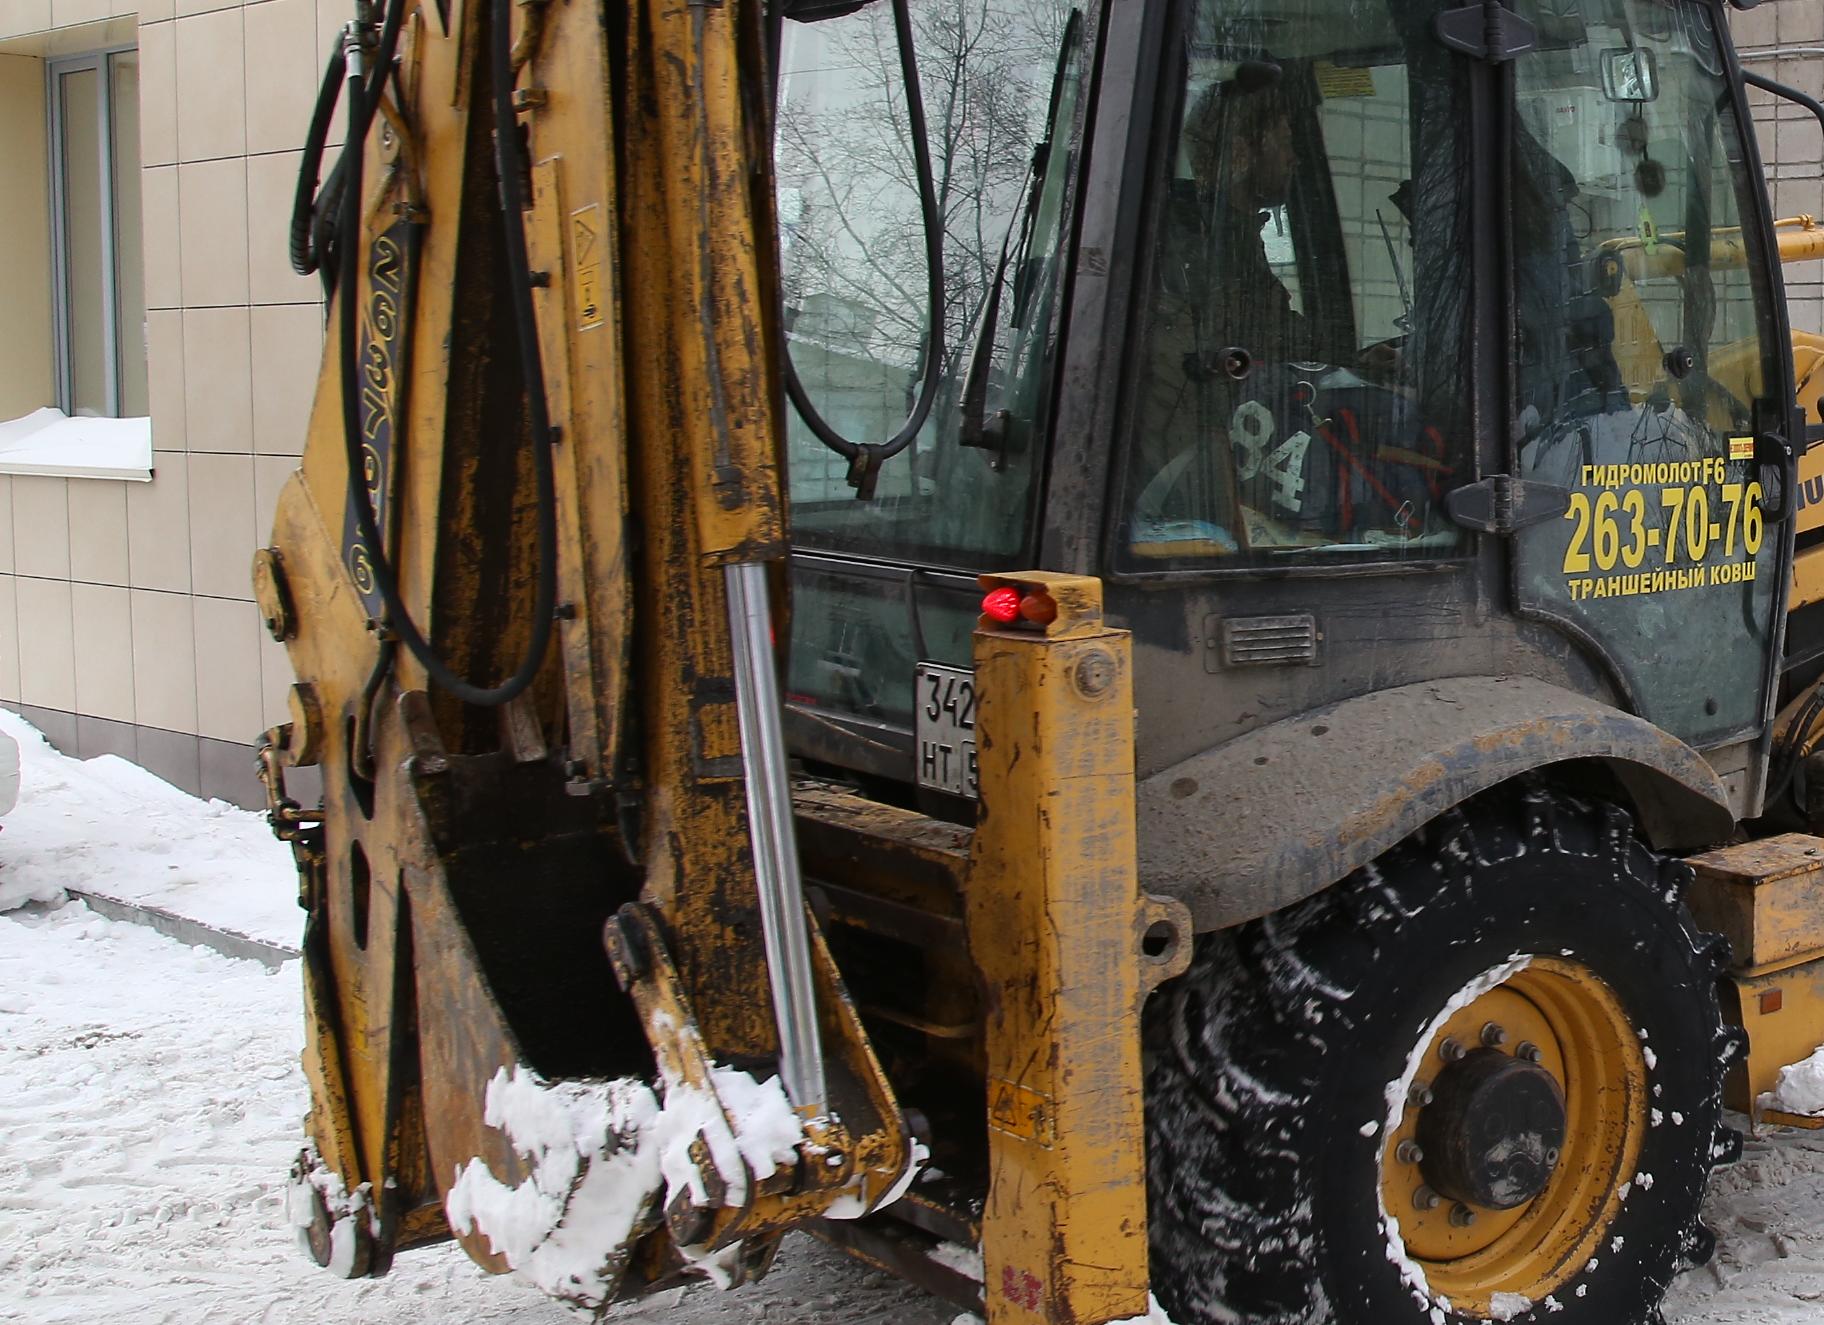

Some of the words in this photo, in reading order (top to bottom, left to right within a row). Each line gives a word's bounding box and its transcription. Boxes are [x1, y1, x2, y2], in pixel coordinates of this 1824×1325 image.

[1581, 461, 1701, 490] ГИДРОМОЛОТ
[1702, 457, 1726, 485] F6
[1563, 481, 1763, 574] 263-70-76
[1568, 563, 1706, 601] ТРАНШЕЙНЫЙ
[1710, 561, 1757, 586] КОВШ
[926, 672, 976, 730] 342
